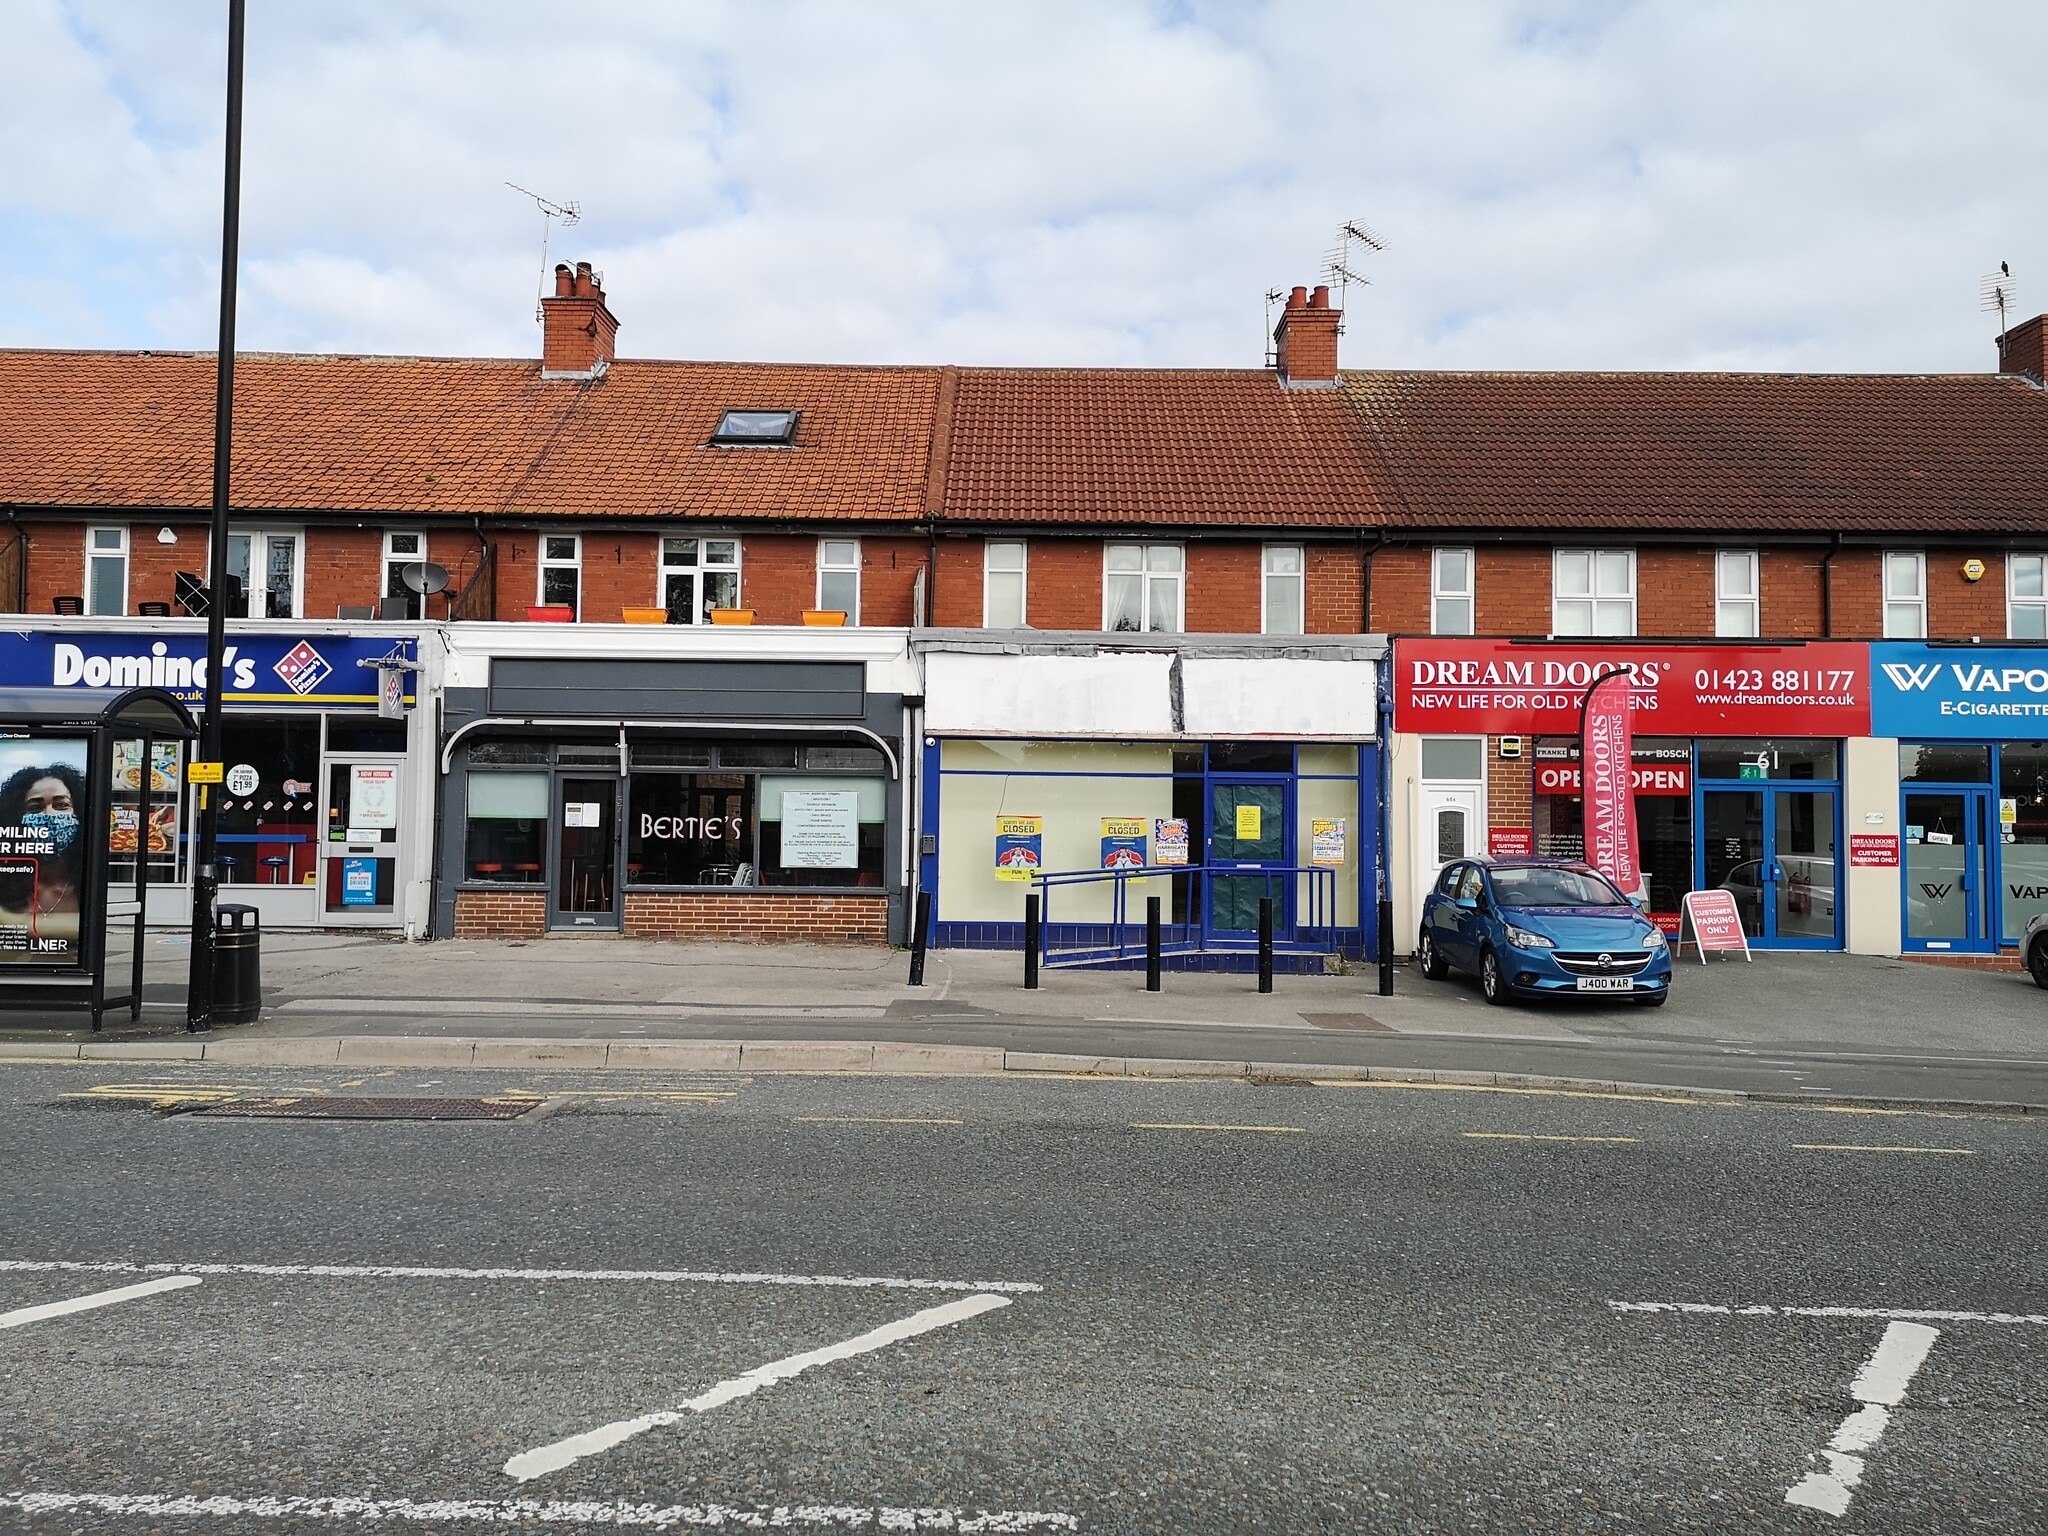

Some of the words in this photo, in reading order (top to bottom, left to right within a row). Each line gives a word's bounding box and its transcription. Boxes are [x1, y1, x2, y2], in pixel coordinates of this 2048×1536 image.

[291, 660, 320, 687] Domino's
[1411, 661, 1534, 686] DREAM
[1695, 669, 1763, 691] 01423
[1771, 670, 1855, 691] 881177
[1412, 694, 1453, 709] NEW
[1458, 694, 1489, 709] LIFE
[1493, 694, 1528, 709] FOR
[1531, 695, 1568, 710] OLD
[1696, 692, 1855, 706] www.dreamdoors.co.uk
[1612, 714, 1626, 772] KITCHENS
[1592, 714, 1612, 793] DOORS
[1656, 750, 1688, 758] BOSCH
[1758, 750, 1778, 770] 61
[232, 780, 252, 790] £1.99
[1617, 775, 1626, 801] OLD
[640, 813, 743, 840] BERTIE'S
[1314, 823, 1337, 836] CIRCUS
[15, 842, 54, 854] HERE
[1595, 799, 1614, 882] DREAM
[1618, 829, 1627, 851] LIFE
[1618, 853, 1632, 882] NEW
[1697, 916, 1735, 925] PARKING
[1707, 926, 1729, 934] ONLY
[30, 937, 67, 951] LNER
[1582, 979, 1607, 988] J400
[1610, 979, 1628, 988] WAR
